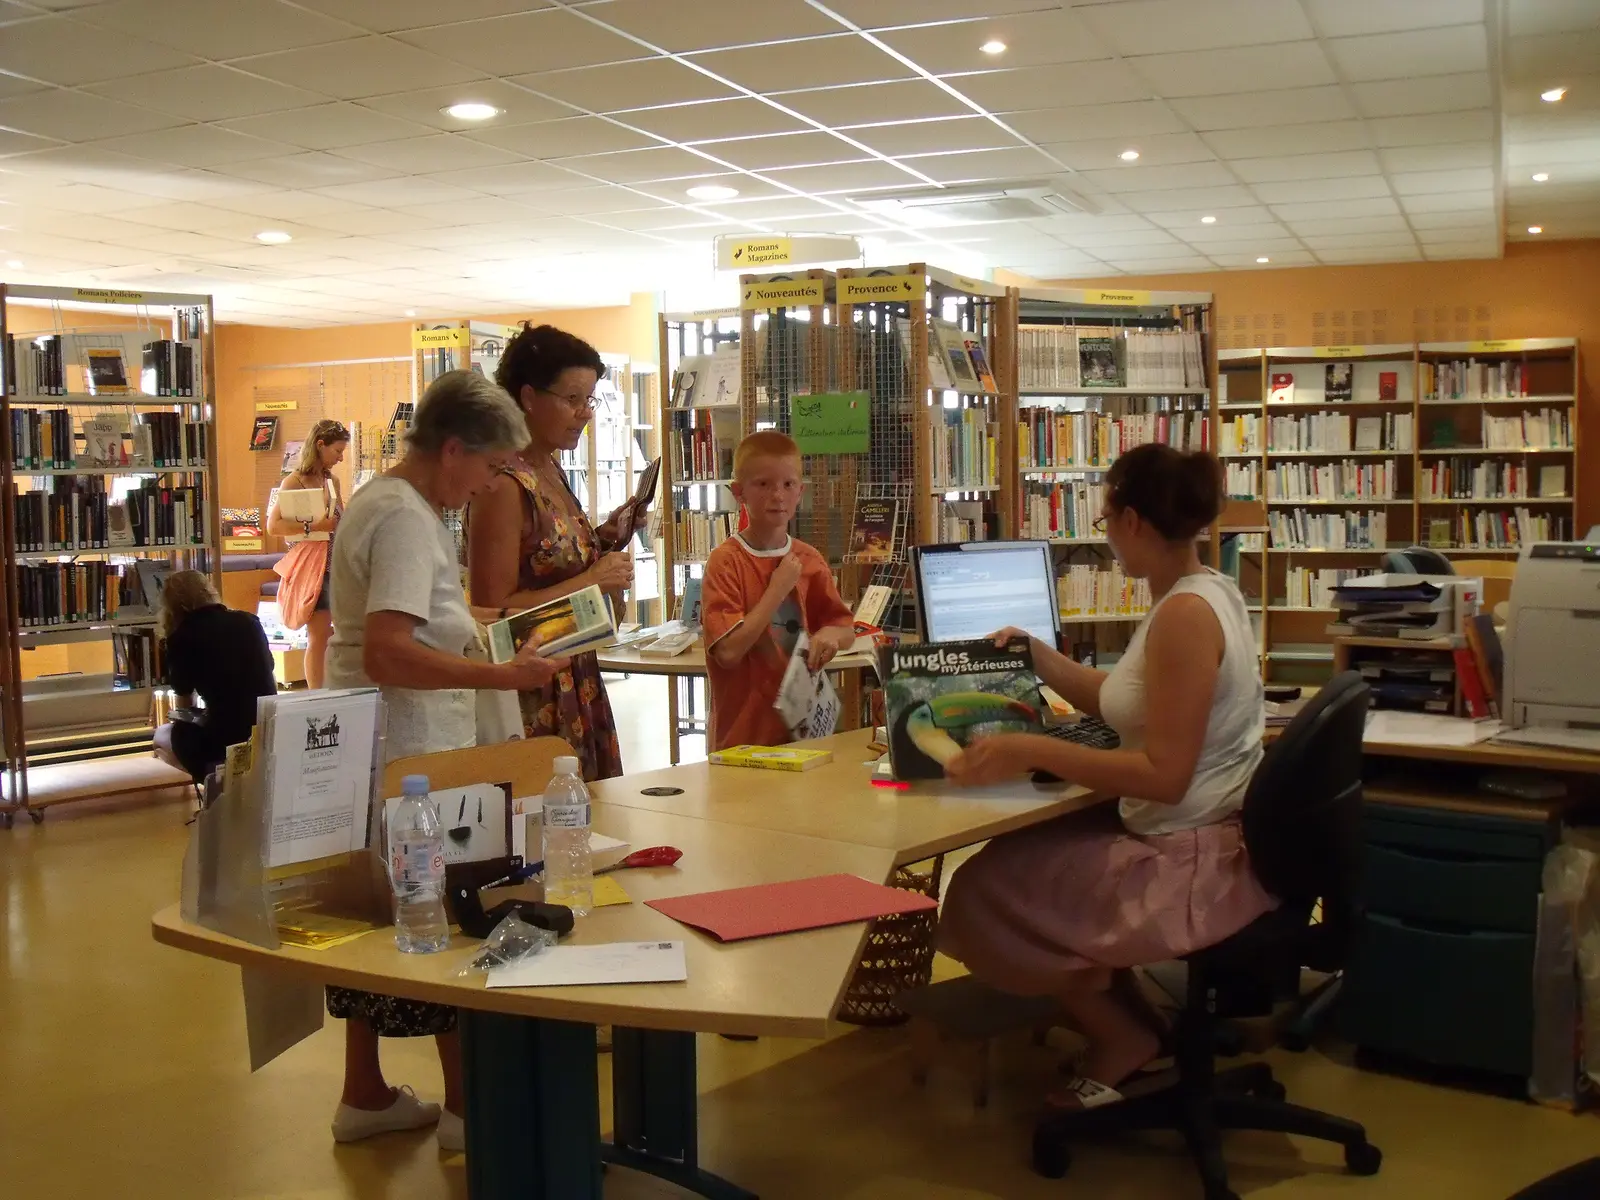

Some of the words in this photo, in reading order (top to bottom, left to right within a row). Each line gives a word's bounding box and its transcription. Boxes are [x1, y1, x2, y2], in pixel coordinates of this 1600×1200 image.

[747, 243, 779, 253] Romans
[747, 252, 788, 263] Magazines
[77, 288, 109, 297] Romans
[110, 290, 142, 299] Policiers
[756, 286, 818, 300] Nouveautés
[847, 284, 898, 295] Provence
[1100, 293, 1134, 301] Provence
[421, 334, 450, 342] Romans
[890, 649, 970, 674] Jungles
[941, 659, 1025, 675] mystérieuses
